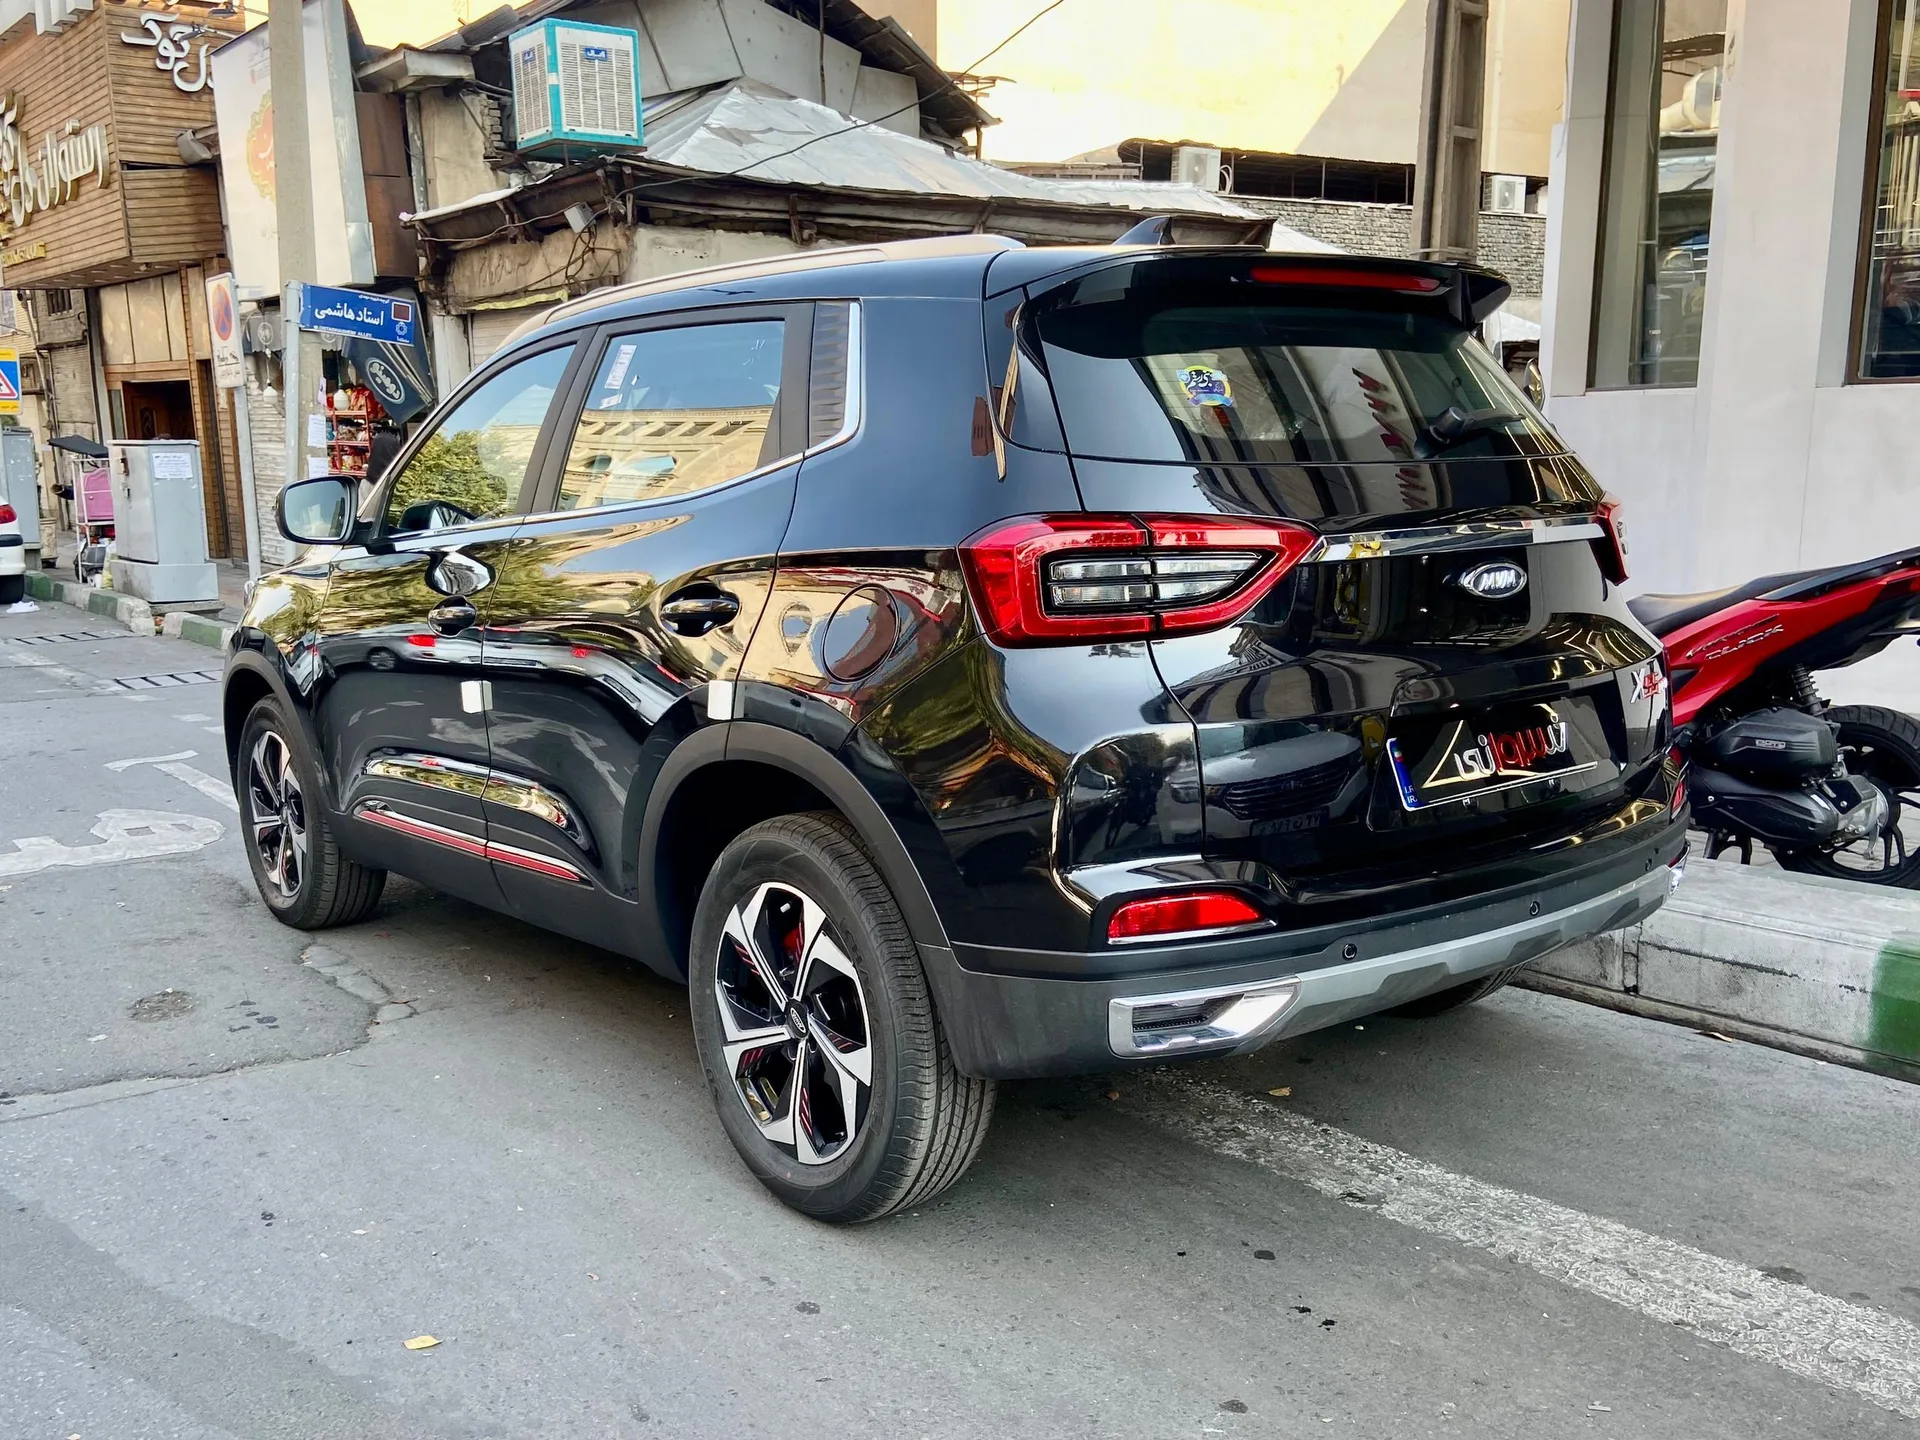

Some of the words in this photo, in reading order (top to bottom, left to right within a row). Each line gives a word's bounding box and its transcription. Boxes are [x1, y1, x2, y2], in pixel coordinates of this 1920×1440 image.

[38, 118, 110, 212] رستوران
[314, 302, 356, 320] هاشمی
[356, 307, 384, 326] استاد
[1479, 569, 1517, 592] MVM
